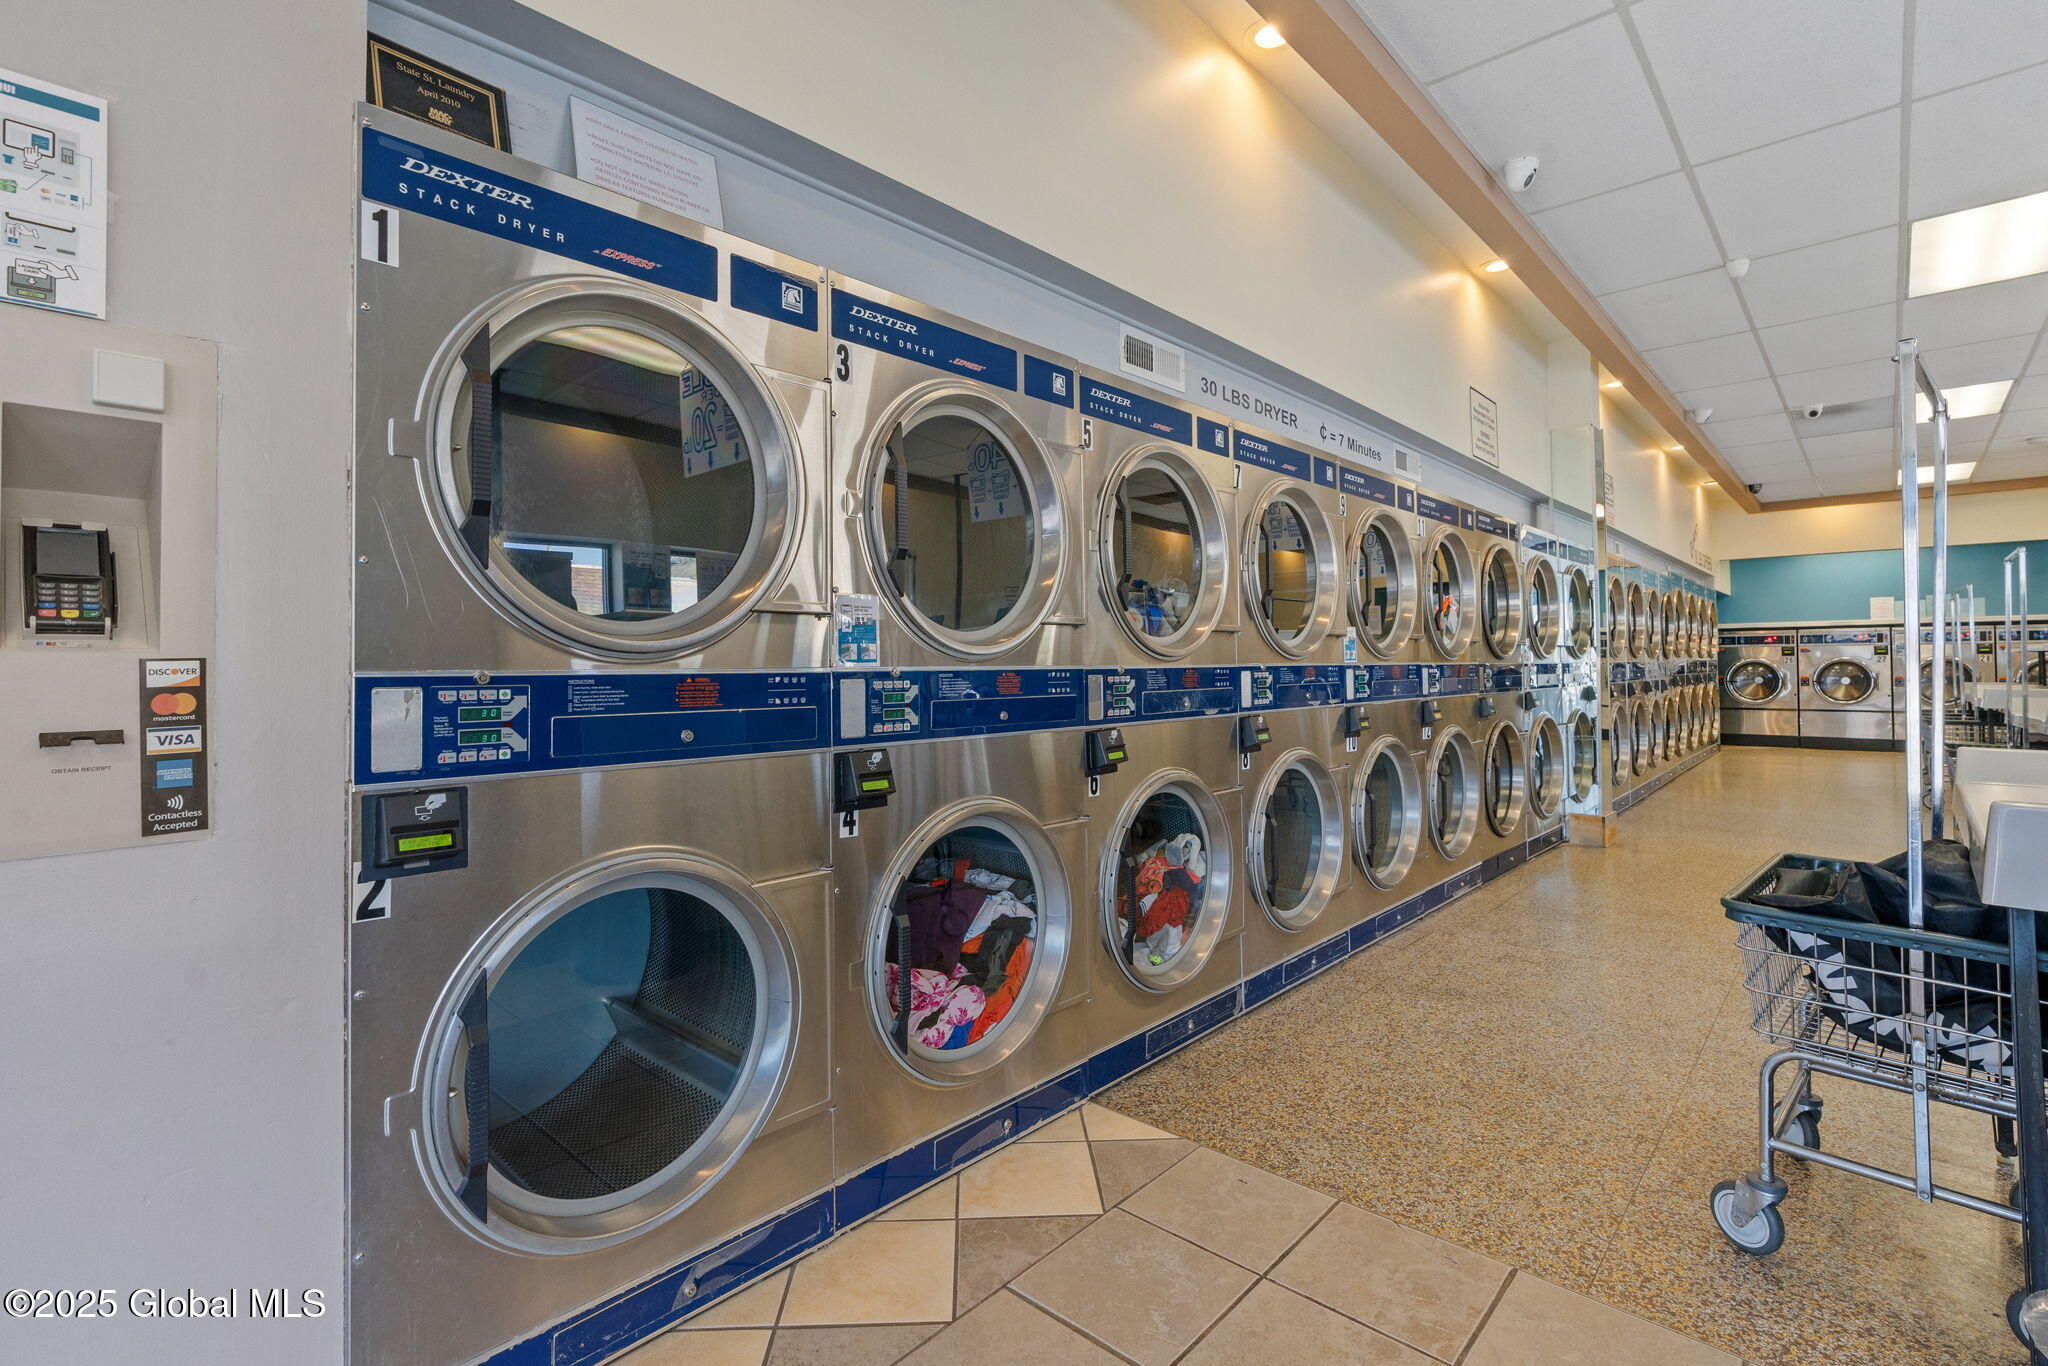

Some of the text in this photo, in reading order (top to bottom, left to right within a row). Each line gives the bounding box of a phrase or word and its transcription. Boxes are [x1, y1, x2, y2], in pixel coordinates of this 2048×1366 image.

[396, 61, 477, 103] State St. Laundry
[417, 86, 461, 109] April 2010
[400, 156, 532, 211] DEXTER
[399, 182, 567, 244] STACK DRYER
[371, 208, 389, 264] 1
[600, 247, 656, 270] EXPRESS
[849, 305, 918, 336] DEXTER
[848, 323, 936, 358] STACK DRYER
[836, 343, 850, 382] 3
[1090, 387, 1132, 408] DEXTER
[1200, 377, 1298, 429] 30 LBS DRYER
[1089, 402, 1142, 424] STACK DRYER
[1083, 419, 1092, 449] 5
[1240, 438, 1269, 453] DEXTER
[1338, 434, 1345, 447] 7
[1347, 437, 1382, 461] Minutes
[1233, 463, 1241, 489] 7
[1339, 493, 1346, 517] 9
[148, 668, 197, 676] DISCOVER
[153, 714, 195, 722] mastercard
[154, 733, 195, 746] VISA
[51, 765, 112, 775] OBTAIN RECEIPT
[148, 810, 203, 821] Contactless
[153, 819, 198, 831] Accepted
[842, 809, 856, 836] 4
[355, 871, 386, 921] 2
